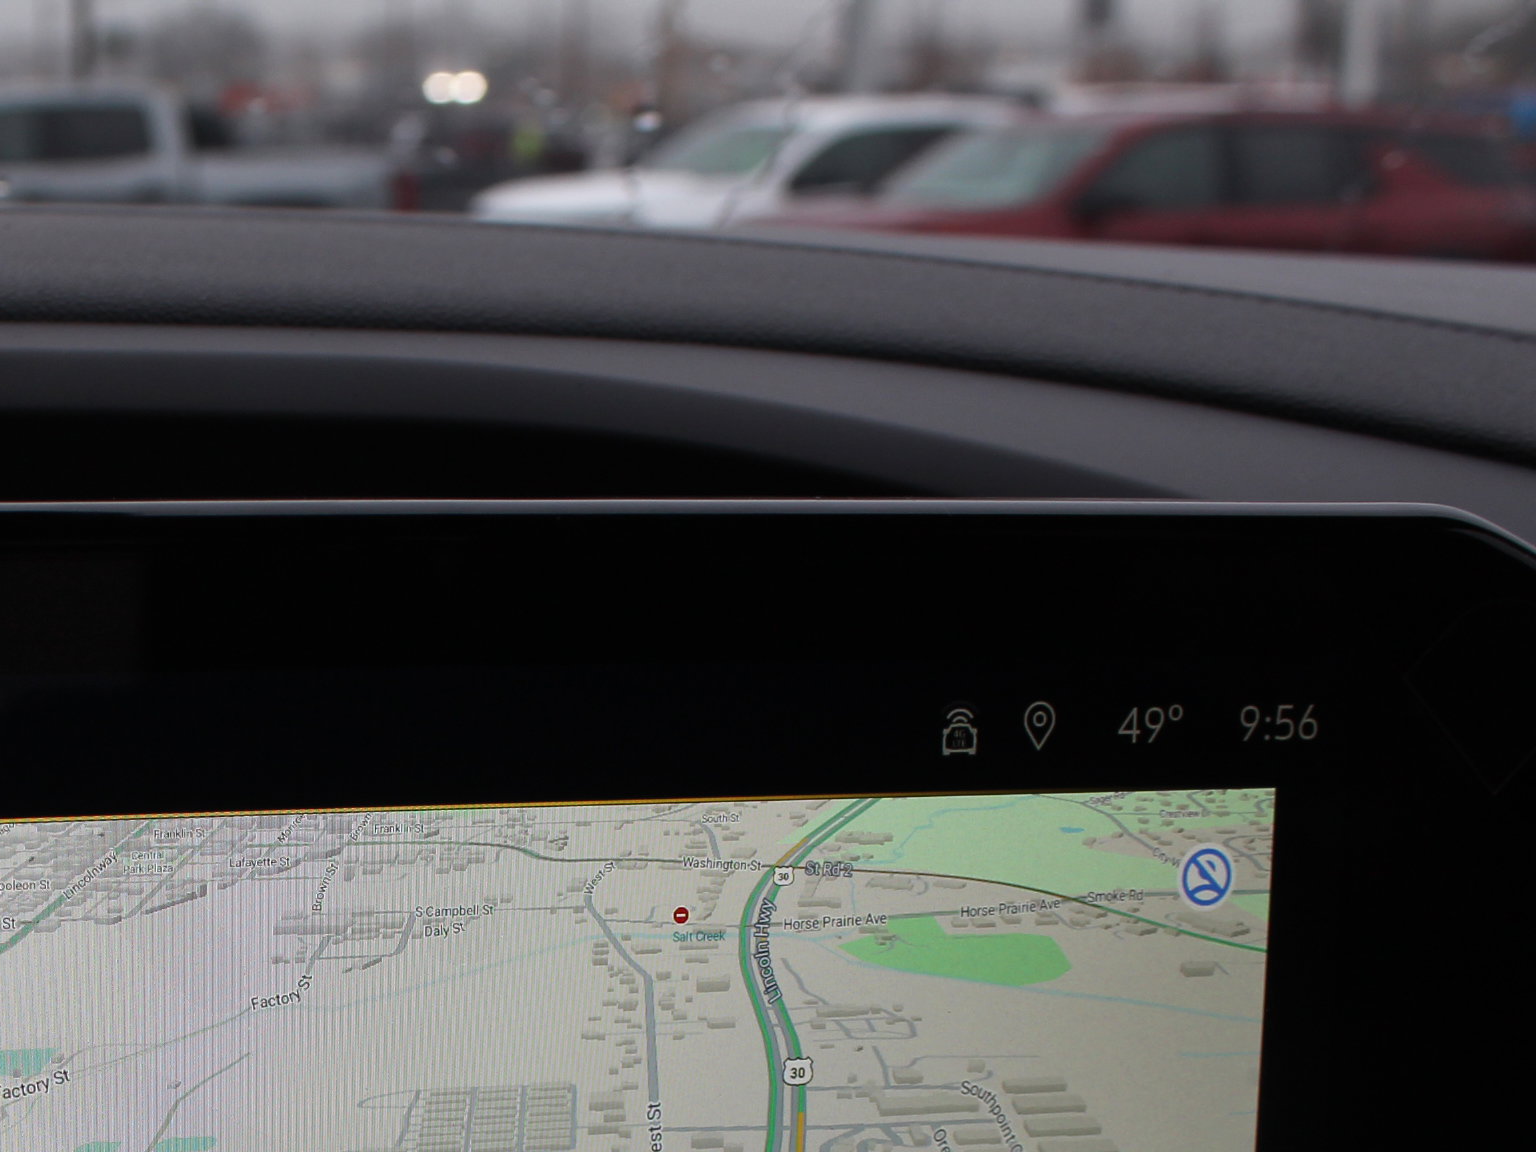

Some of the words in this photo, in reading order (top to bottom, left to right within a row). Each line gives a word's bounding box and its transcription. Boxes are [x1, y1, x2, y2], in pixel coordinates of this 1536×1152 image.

[1239, 704, 1319, 743] 9:56
[702, 814, 729, 823] South
[731, 814, 739, 822] St
[154, 828, 193, 839] Franklin
[196, 828, 206, 838] St
[351, 811, 372, 842] Brown
[374, 823, 411, 834] Franklin
[414, 822, 425, 833] St
[229, 858, 277, 870] Lafayette
[280, 857, 291, 867] St
[682, 857, 747, 871] Washington
[749, 860, 761, 871] St
[805, 863, 819, 876] St
[823, 863, 840, 876] Rd
[844, 864, 853, 877] 2
[64, 850, 118, 901] Lincolnway
[584, 869, 606, 895] West
[603, 861, 617, 875] St
[778, 872, 789, 881] 30
[40, 879, 51, 890] St
[312, 873, 331, 911] Brown
[326, 863, 338, 877] St
[1087, 891, 1125, 903] Smoke
[1128, 890, 1144, 901] Rd
[415, 906, 422, 917] S
[424, 904, 479, 918] Campbell
[480, 904, 494, 916] St
[961, 904, 996, 918] Horse
[999, 902, 1035, 917] Prairie
[1039, 898, 1061, 914] Ave
[1, 918, 17, 930] St
[754, 898, 777, 939] Hwy
[783, 919, 819, 931] Horse
[823, 915, 862, 928] Prairie
[865, 914, 887, 925] Ave
[424, 923, 449, 938] Daly
[451, 922, 465, 935] St
[673, 931, 695, 942] Salt
[696, 930, 726, 942] Creek
[754, 941, 783, 1005] Lincoln
[251, 990, 301, 1011] Factory
[298, 974, 312, 992] St
[53, 1070, 70, 1085] St
[790, 1066, 806, 1079] 30
[648, 1101, 661, 1125] St
[960, 1080, 1016, 1146] Southpoint
